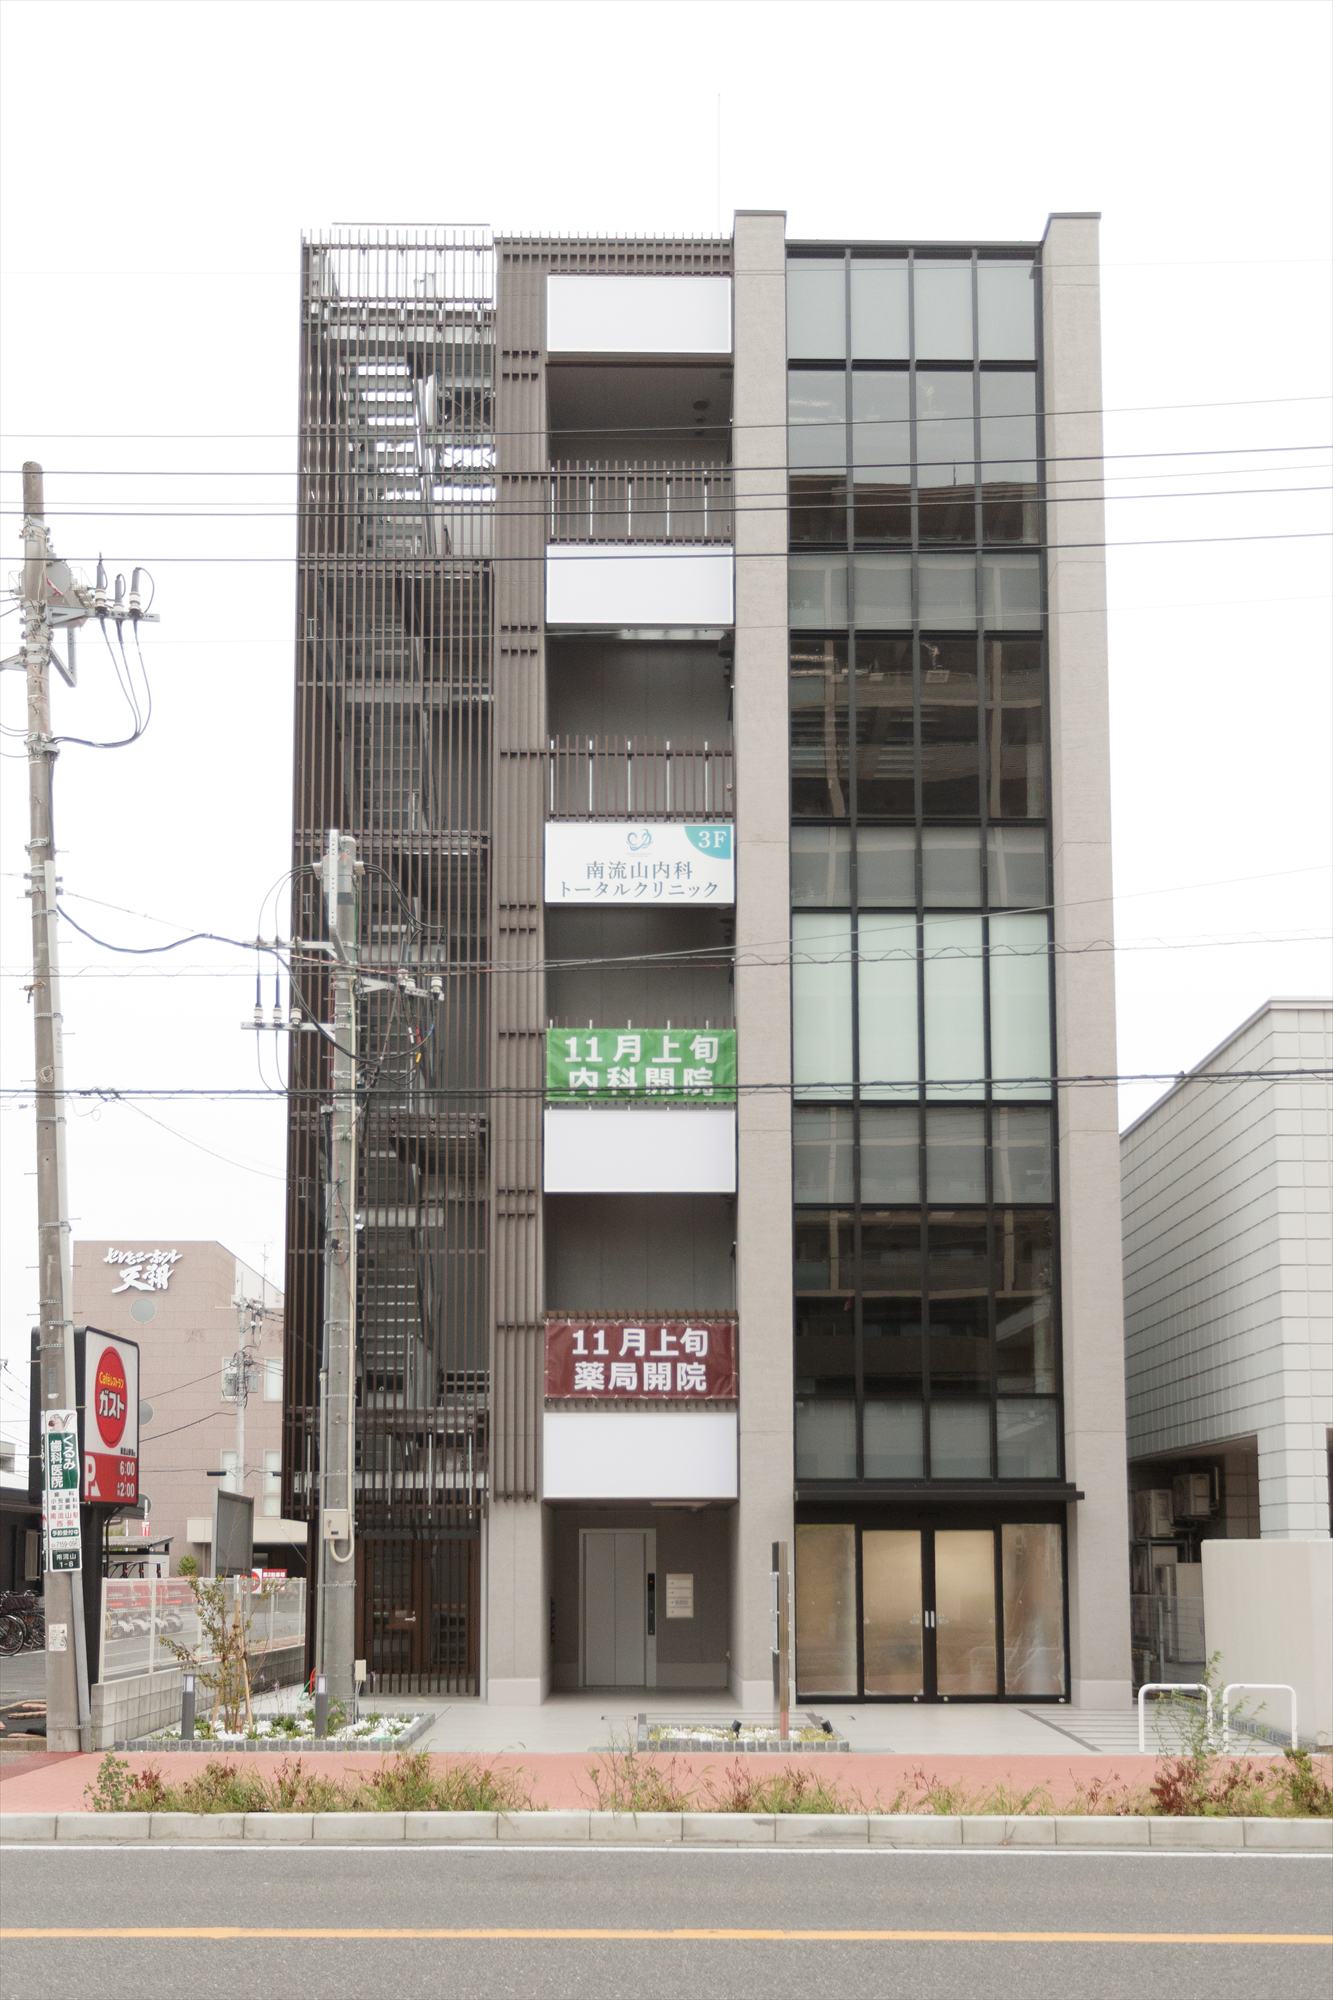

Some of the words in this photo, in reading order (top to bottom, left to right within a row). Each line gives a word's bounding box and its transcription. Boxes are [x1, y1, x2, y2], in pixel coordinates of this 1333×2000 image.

[698, 831, 727, 848] 3F
[586, 861, 693, 880] 南流山内科
[561, 881, 718, 898] トータルクリニック
[564, 1034, 719, 1063] 11月上旬
[569, 1066, 714, 1096] 内科開院
[572, 1328, 709, 1357] 11月上旬
[574, 1361, 707, 1392] 薬局開院
[99, 1390, 125, 1420] ガスト
[50, 1440, 63, 1488] 歯科医院
[63, 1435, 75, 1470] くるみ
[85, 1454, 96, 1496] P
[119, 1461, 135, 1476] 6:00
